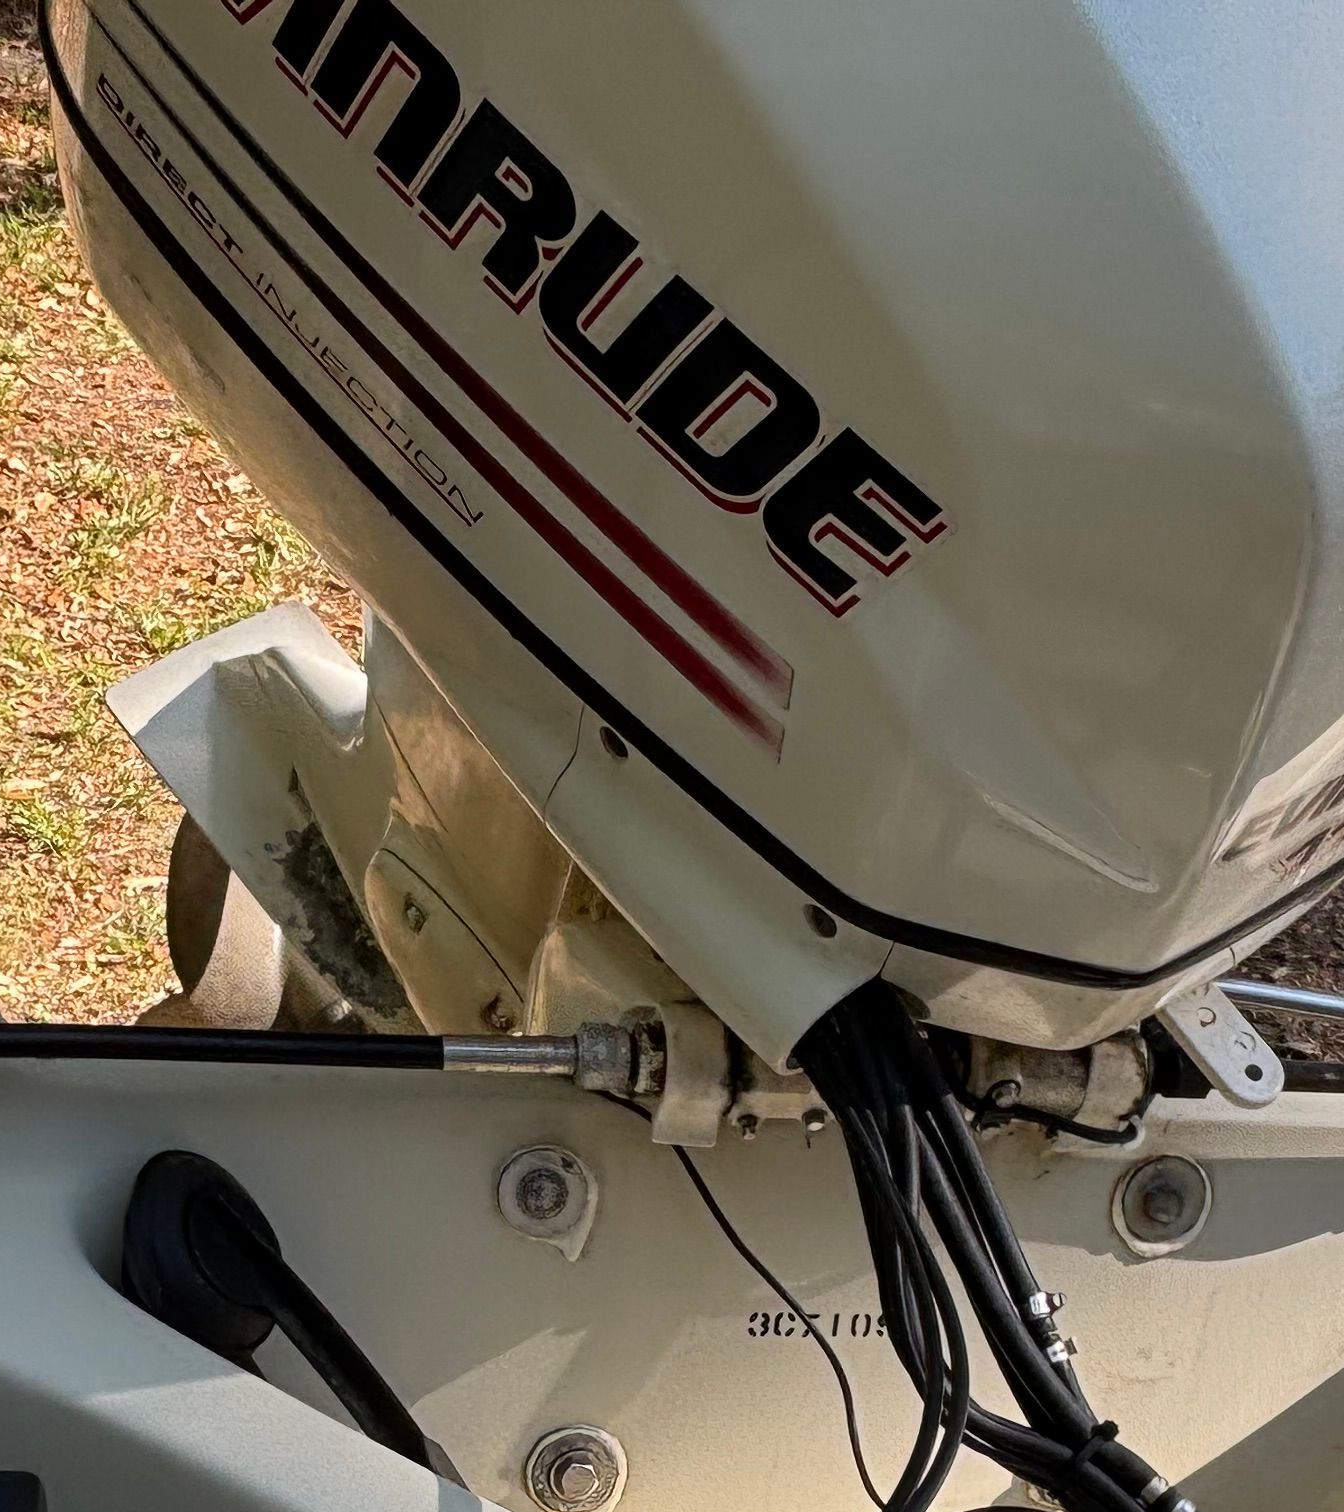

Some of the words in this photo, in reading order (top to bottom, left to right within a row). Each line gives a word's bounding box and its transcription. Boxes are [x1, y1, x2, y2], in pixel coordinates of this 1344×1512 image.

[97, 73, 244, 254] DIRECT
[256, 272, 484, 524] INJECTION
[219, 0, 944, 618] INRUDE
